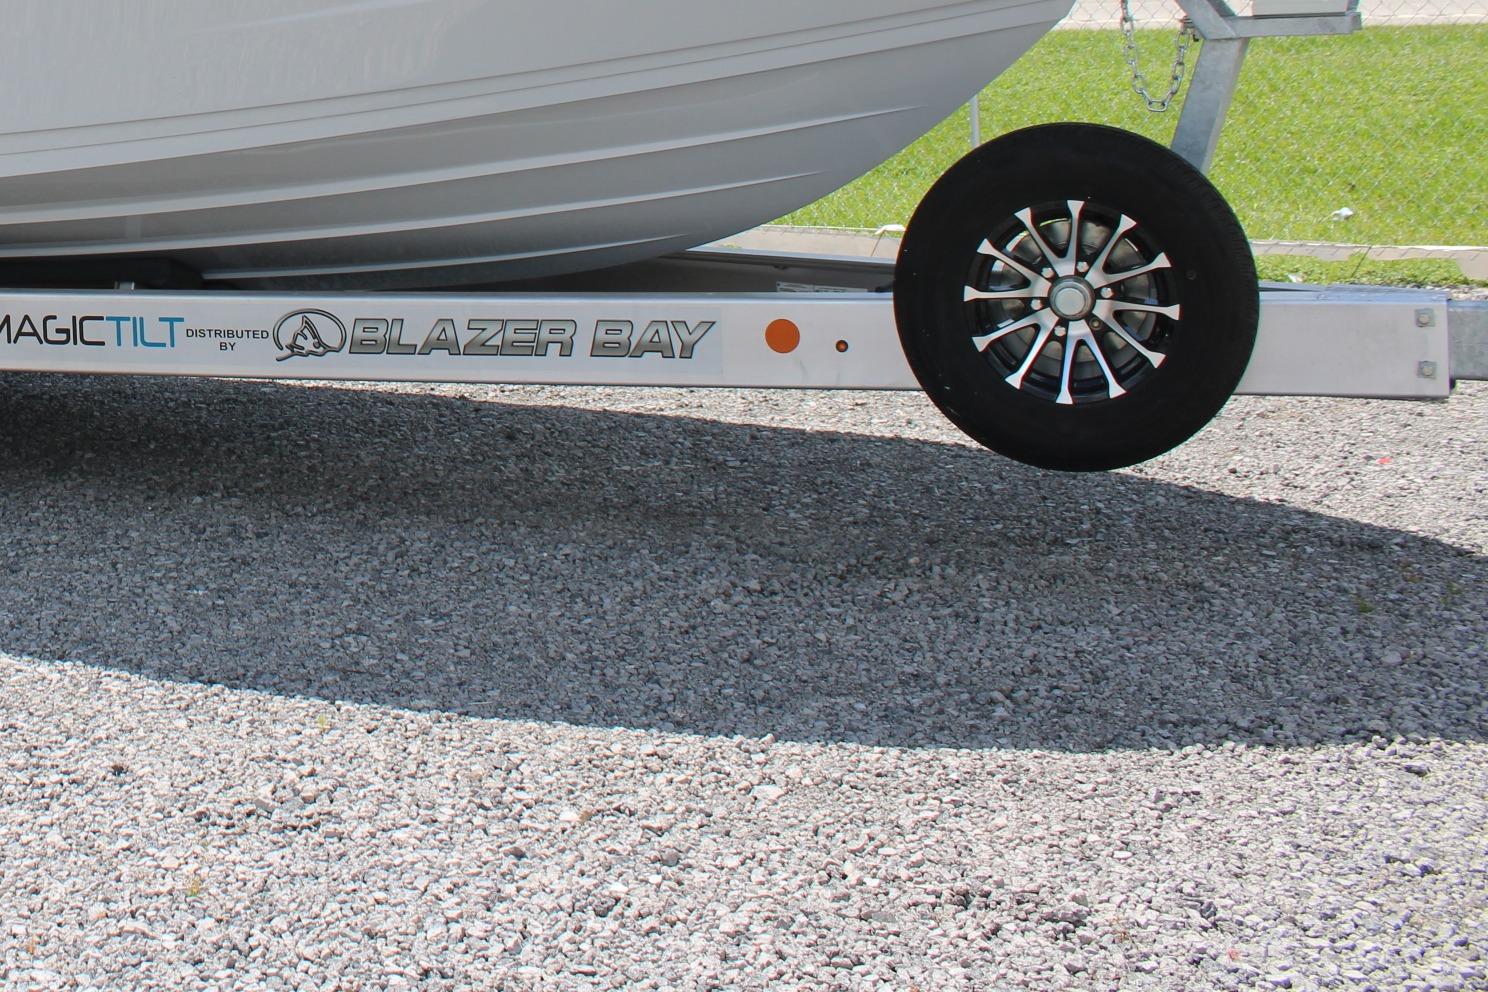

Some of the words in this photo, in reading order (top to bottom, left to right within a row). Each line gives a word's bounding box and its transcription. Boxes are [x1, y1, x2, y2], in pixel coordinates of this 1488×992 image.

[186, 327, 270, 340] DISTRIBUTED
[348, 317, 577, 357] BLAZER
[589, 318, 716, 359] BAY
[219, 341, 237, 352] BY
